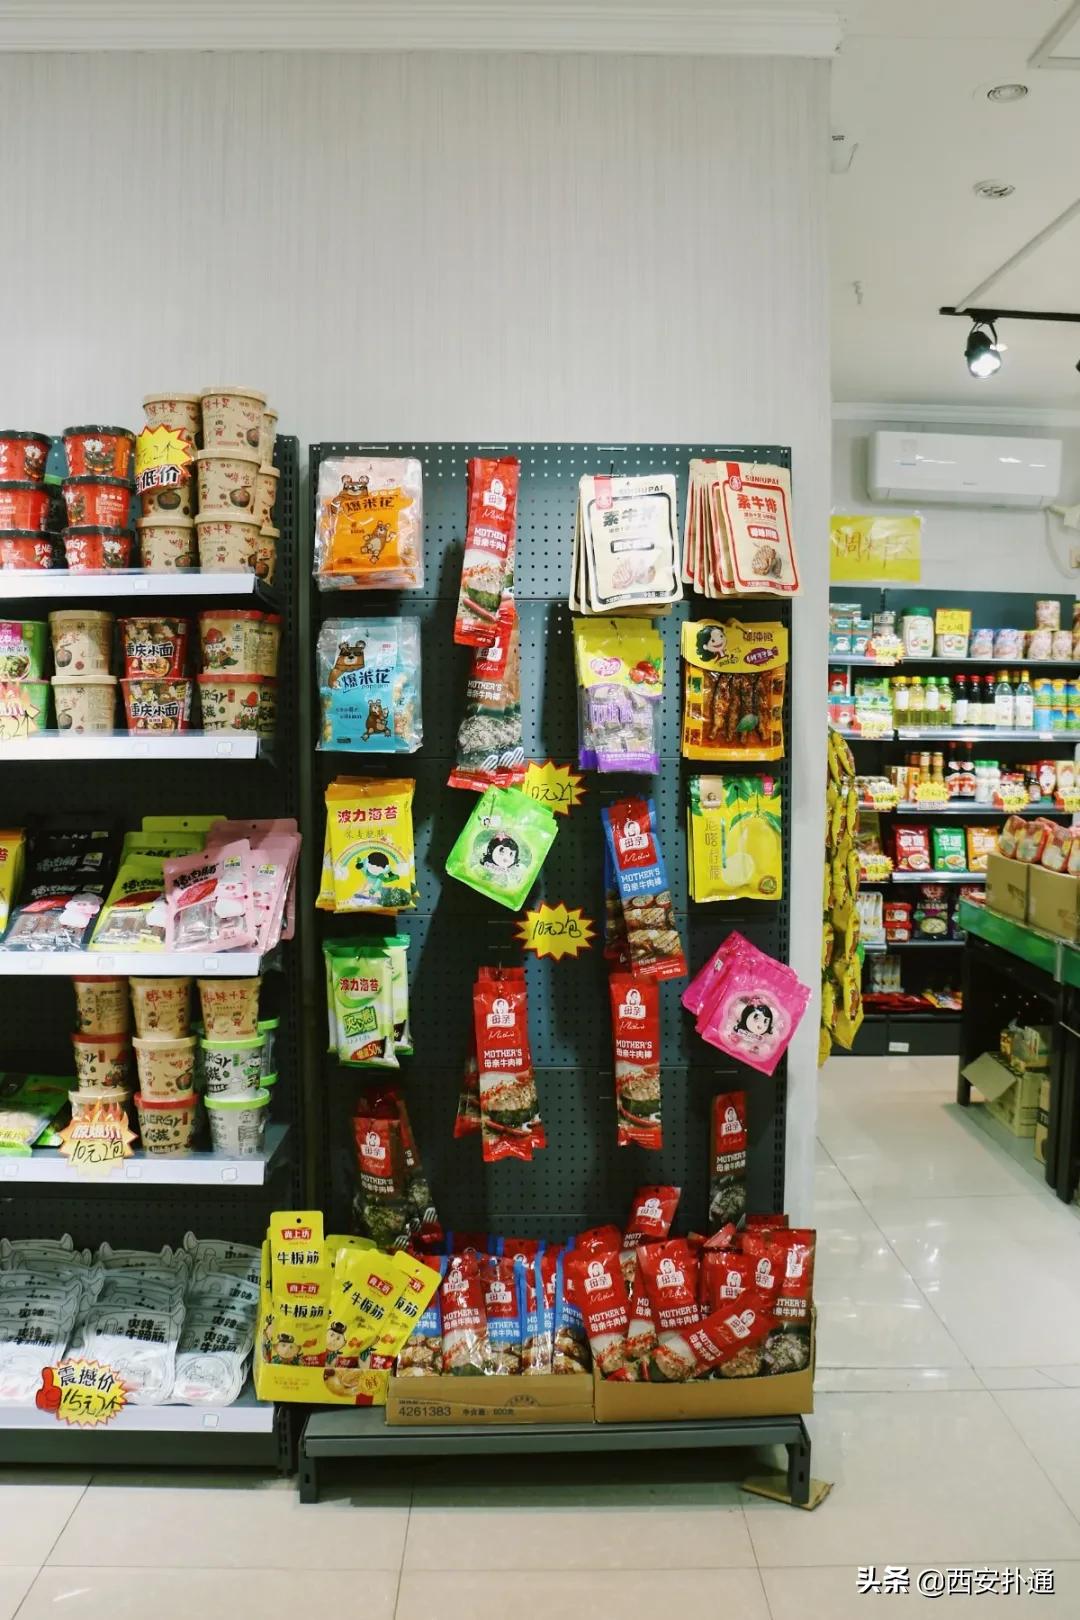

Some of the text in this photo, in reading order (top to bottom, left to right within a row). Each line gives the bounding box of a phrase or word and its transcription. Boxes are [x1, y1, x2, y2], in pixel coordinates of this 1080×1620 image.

[126, 641, 174, 657] 重庆小面
[341, 667, 392, 689] 爆米花
[131, 703, 179, 718] 重庆小面
[337, 805, 398, 823] 波力海苔
[620, 871, 661, 884] MOTHER'S
[622, 879, 663, 893] 母亲牛肉棒
[532, 917, 582, 940] 10元2包
[339, 977, 379, 992] 波力海苔
[616, 1040, 653, 1050] MOTHER'S
[483, 1048, 523, 1060] MOTHER'S
[616, 1049, 653, 1059] 母亲牛肉棒
[483, 1058, 523, 1068] 母亲牛肉棒
[72, 1138, 124, 1163] 10元2包
[277, 1250, 320, 1266] 牛板筋
[280, 1303, 324, 1318] 牛板筋
[352, 1292, 385, 1321] 牛板筋
[658, 1304, 698, 1319] MOTHER'S
[443, 1308, 480, 1322] MOTHER'S
[588, 1306, 626, 1324] MOTHER'S
[660, 1313, 700, 1328] 母亲牛肉棒
[128, 1319, 154, 1330] 爽辣
[590, 1315, 629, 1334] 母亲牛肉棒
[125, 1328, 166, 1344] 牛蹄筋
[58, 1365, 114, 1393] 震撼价
[398, 1406, 451, 1417] 4261383
